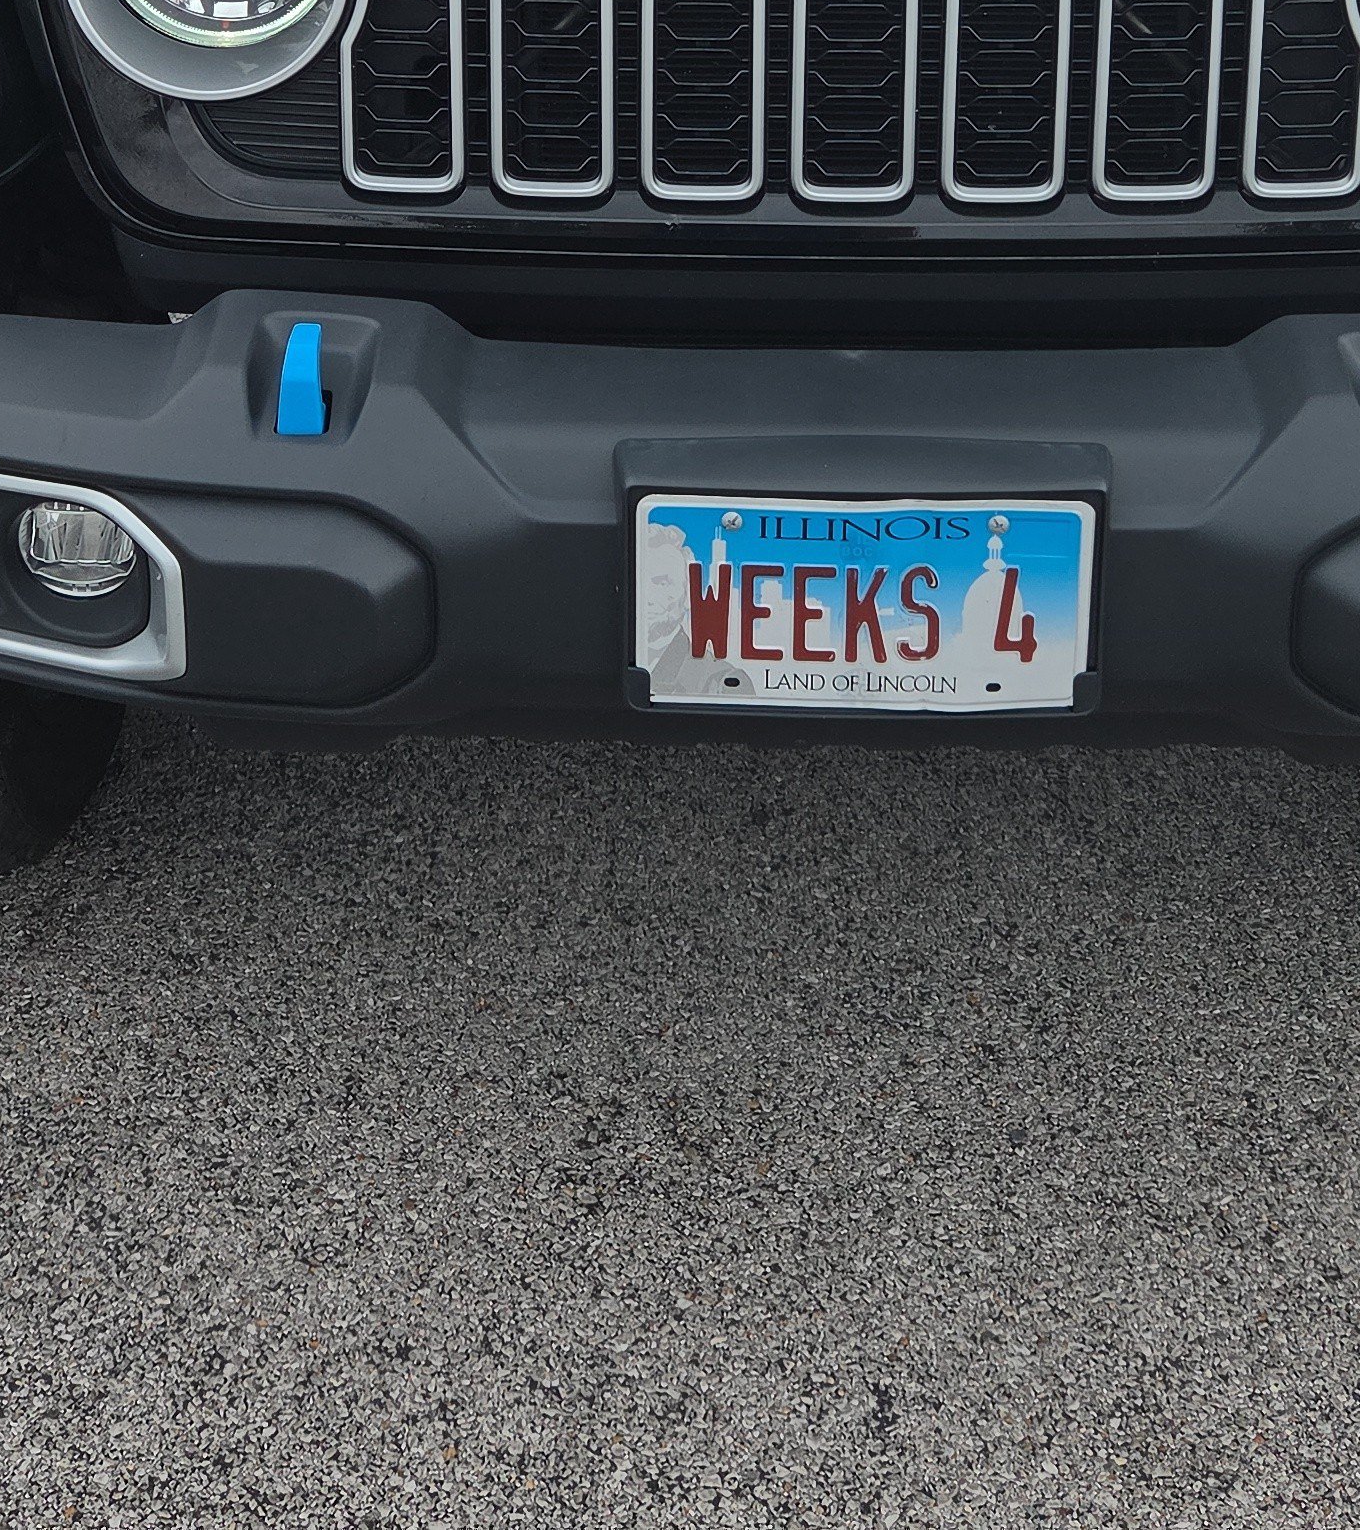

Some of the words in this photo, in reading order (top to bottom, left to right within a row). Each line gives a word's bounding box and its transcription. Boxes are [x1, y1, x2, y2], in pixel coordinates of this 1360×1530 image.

[758, 515, 971, 542] ILLINOIS
[688, 563, 940, 664] WEEKS
[993, 566, 1038, 664] 4
[764, 669, 826, 692] LAND
[865, 671, 958, 694] LINCOLN
